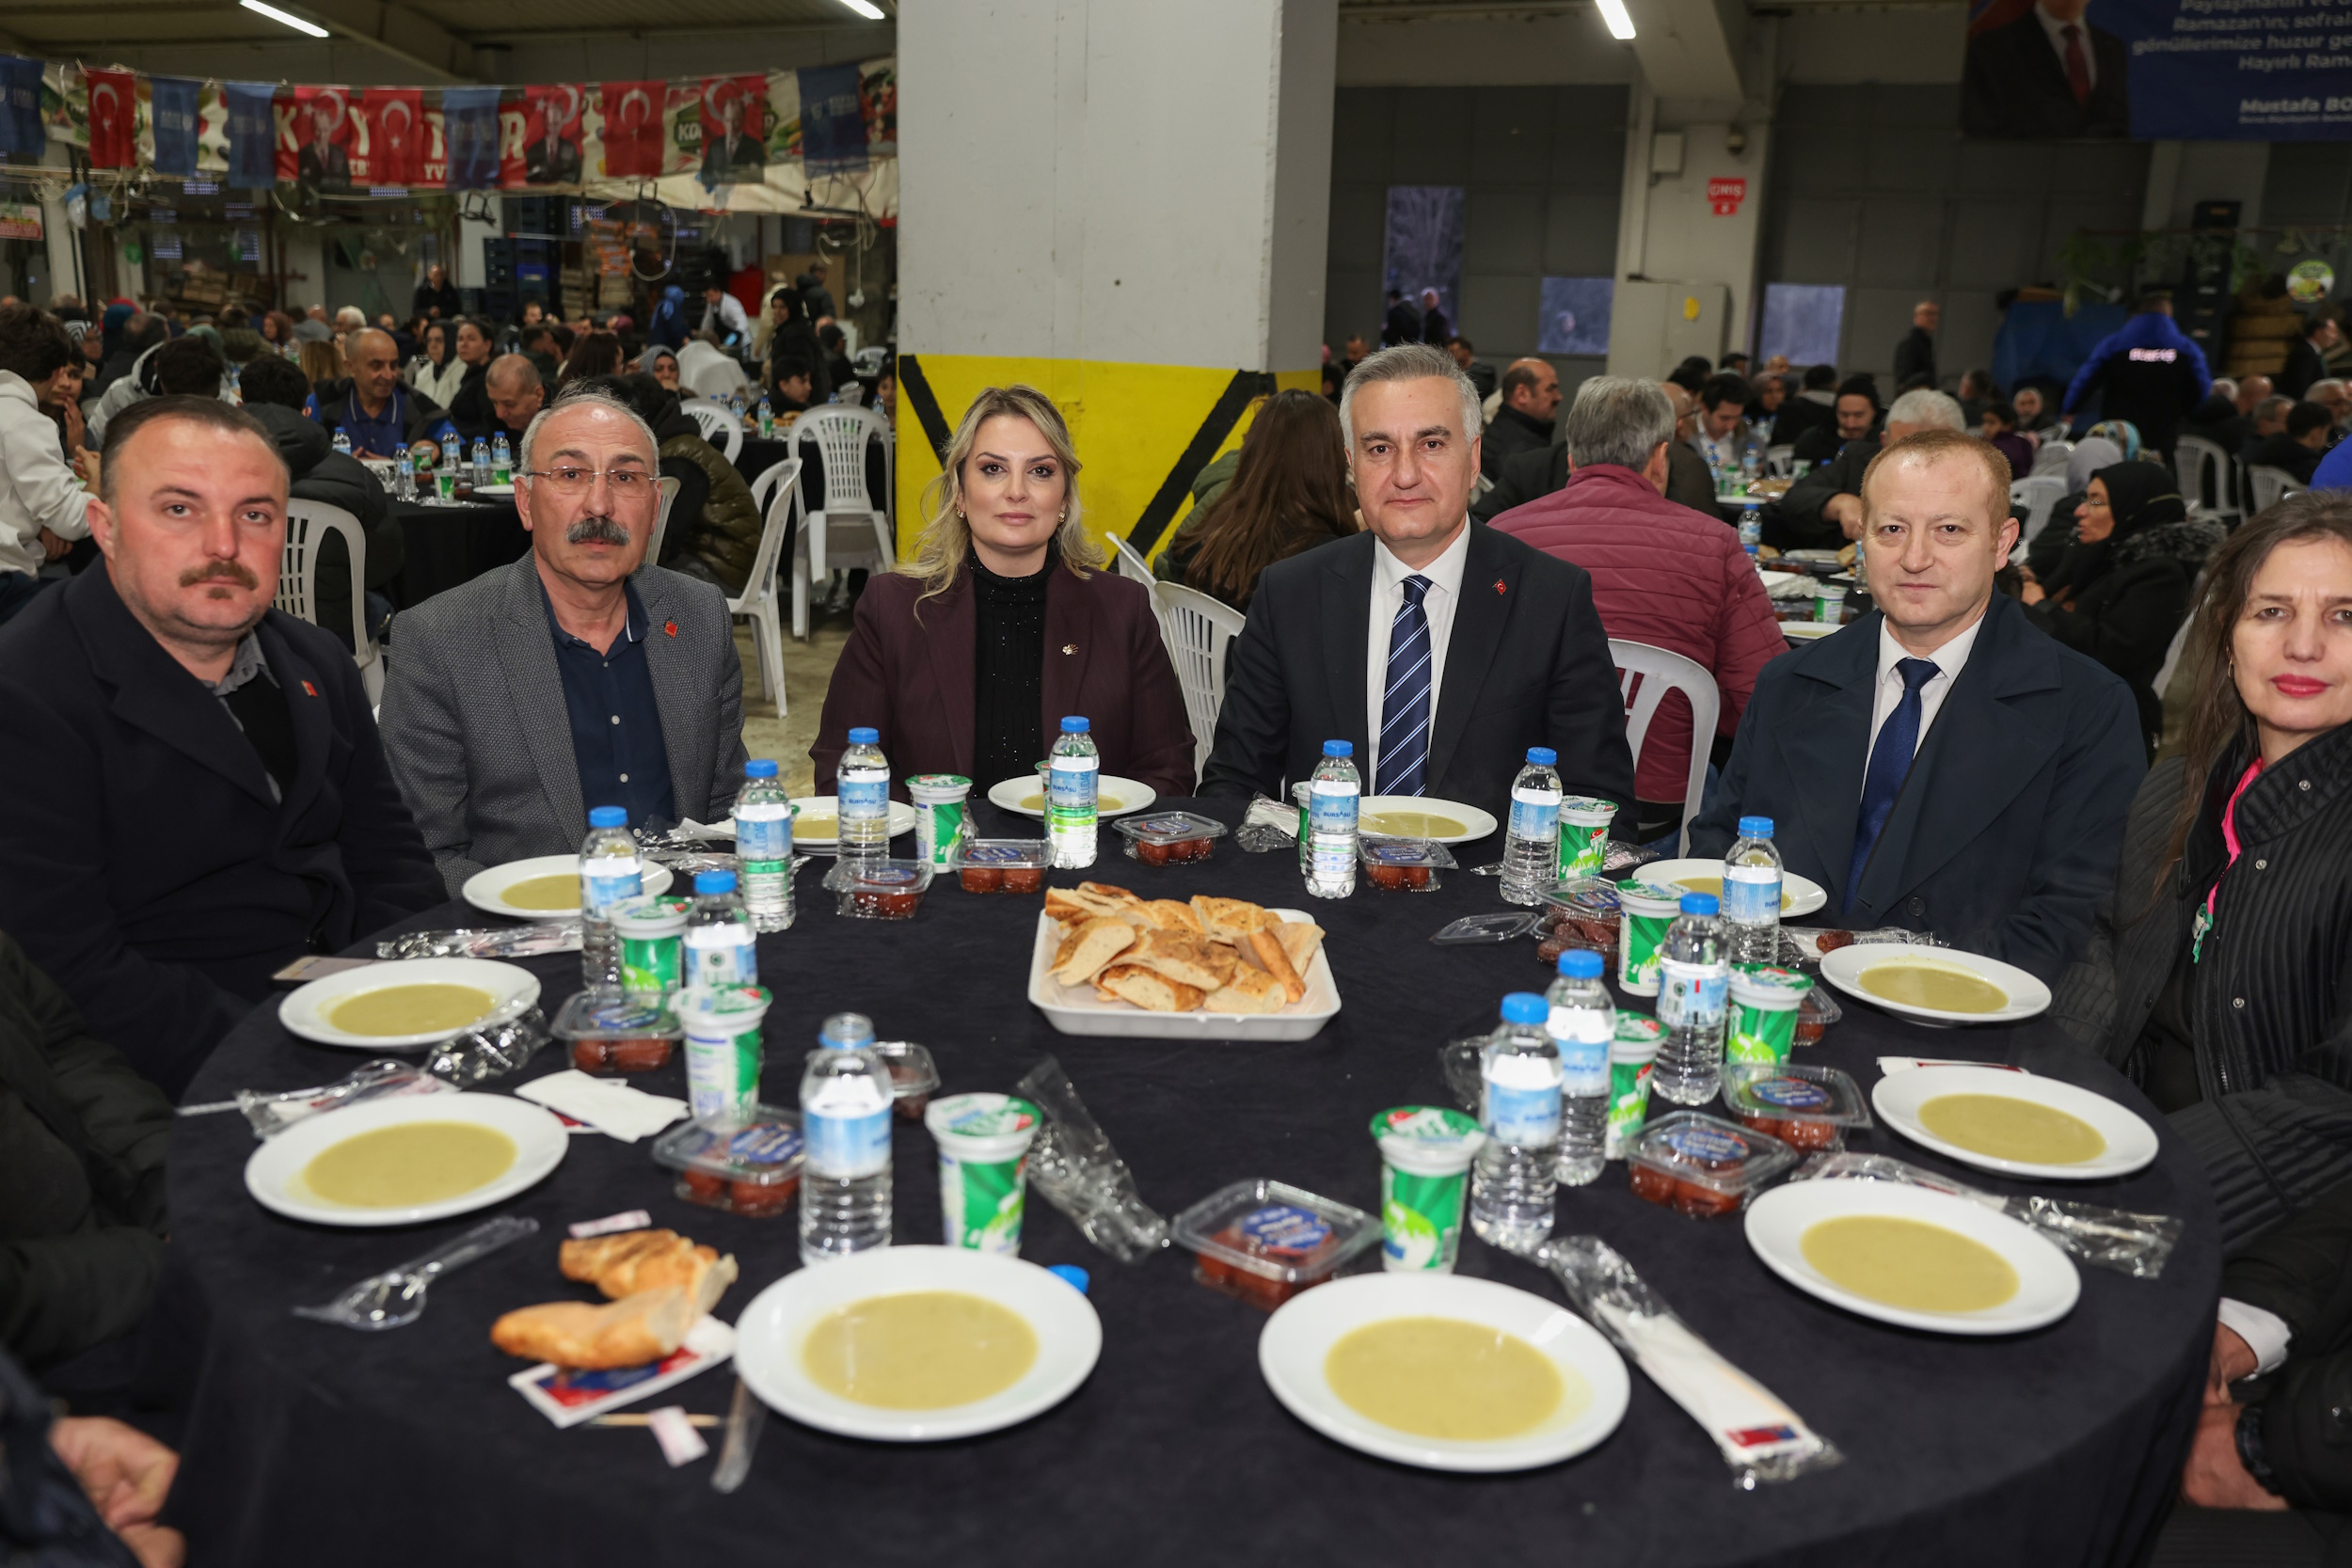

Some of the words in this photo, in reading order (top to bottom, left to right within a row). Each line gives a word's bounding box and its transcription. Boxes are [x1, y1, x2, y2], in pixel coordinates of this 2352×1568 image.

[2294, 11, 2352, 29] sofral
[2266, 34, 2325, 50] huzur
[2328, 35, 2352, 51] ge
[2239, 97, 2321, 113] Mustafa
[2325, 97, 2352, 112] BO
